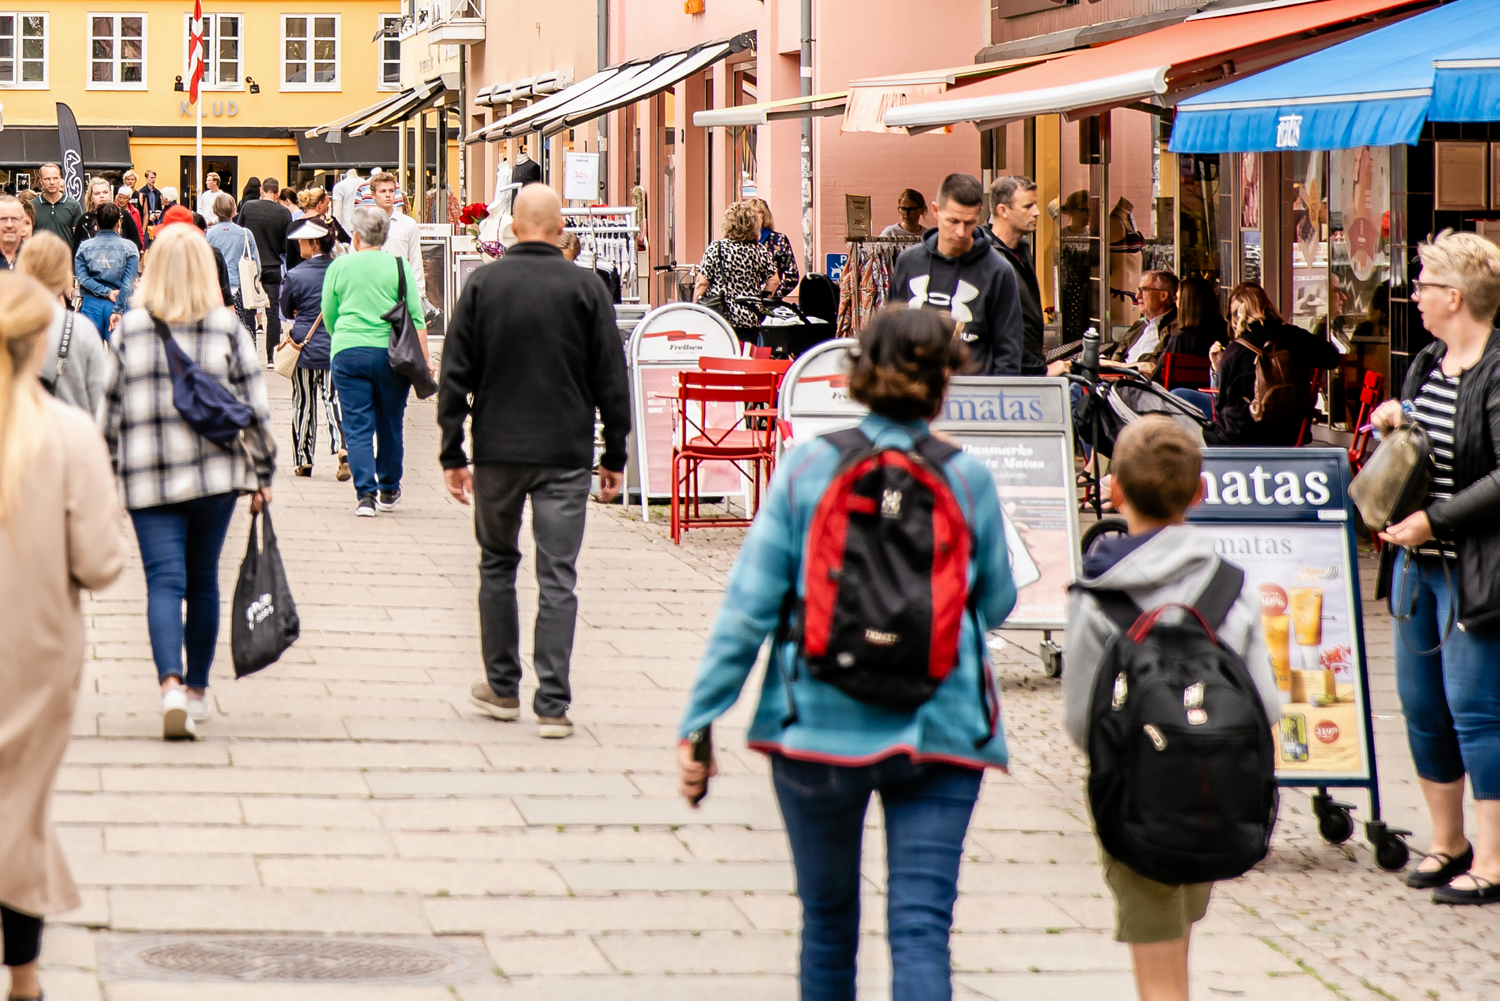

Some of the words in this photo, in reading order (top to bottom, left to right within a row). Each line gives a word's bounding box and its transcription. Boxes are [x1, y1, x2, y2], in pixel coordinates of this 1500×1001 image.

[943, 389, 1043, 421] matas
[961, 443, 1034, 457] Danmarks
[1002, 457, 1045, 469] Matas
[1213, 535, 1292, 555] matas
